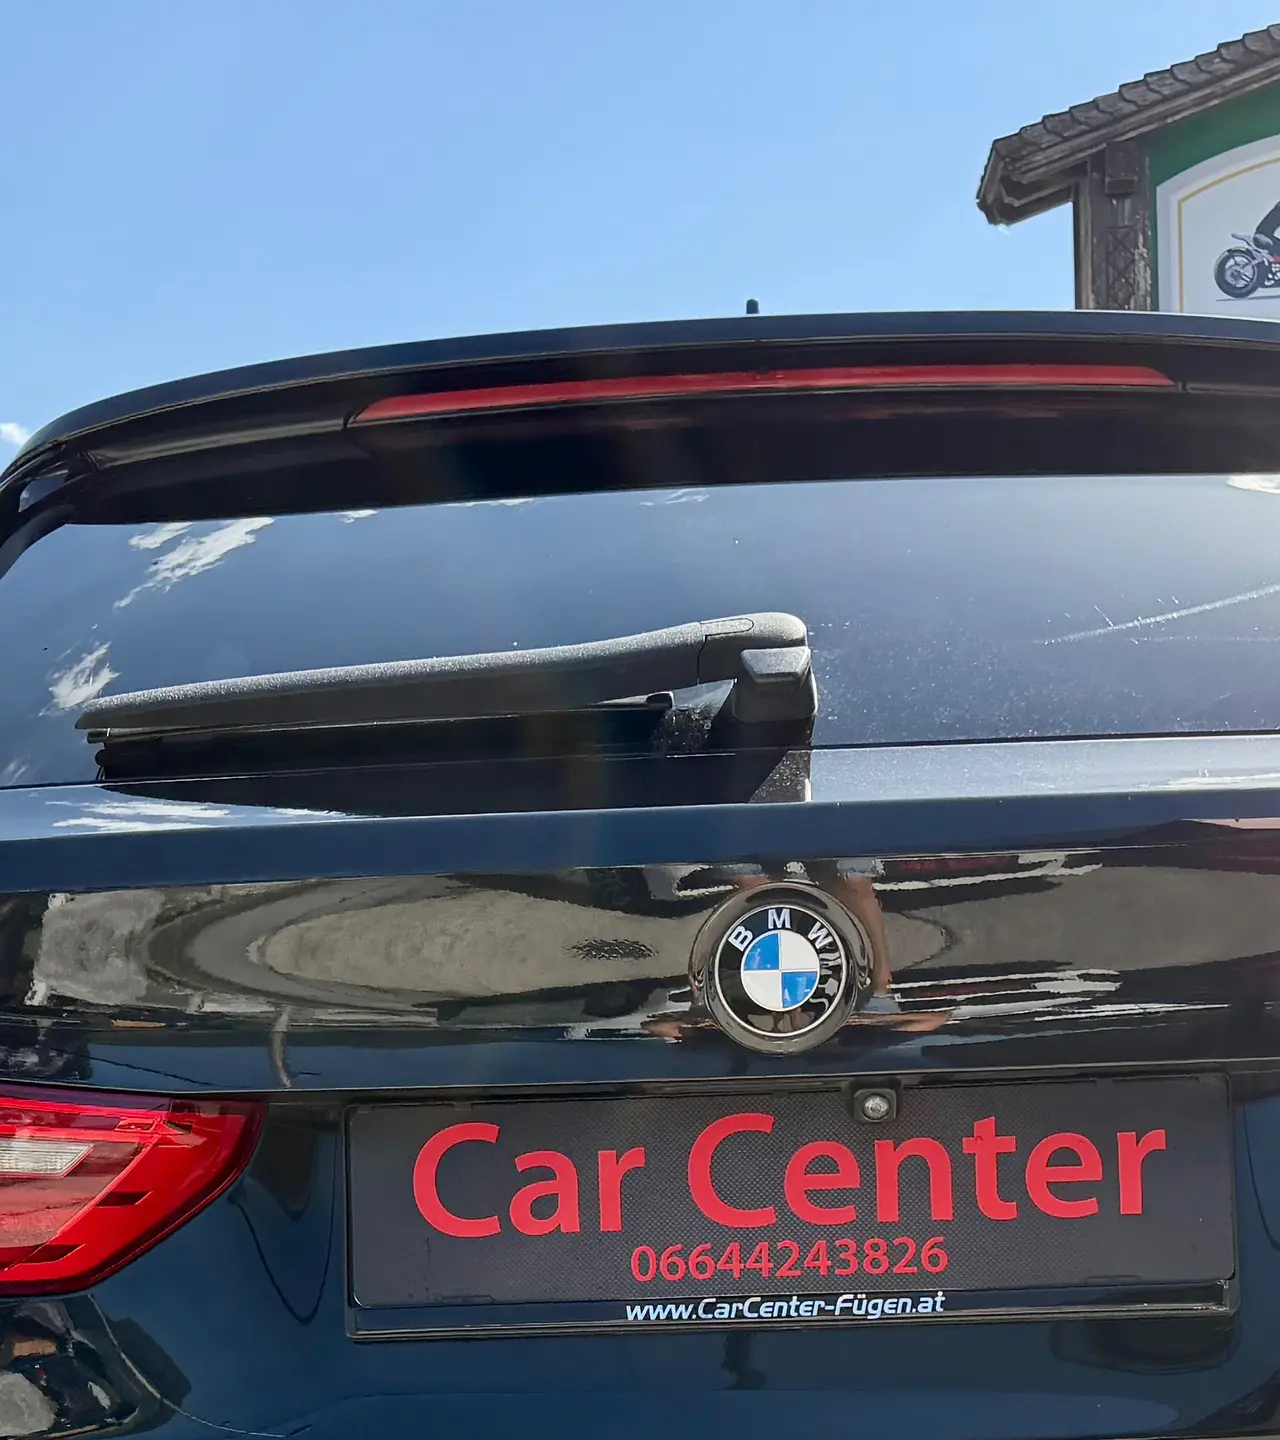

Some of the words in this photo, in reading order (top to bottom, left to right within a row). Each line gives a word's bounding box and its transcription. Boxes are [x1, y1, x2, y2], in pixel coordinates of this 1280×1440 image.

[728, 908, 835, 952] BMW
[412, 1121, 647, 1240] Car
[687, 1112, 1168, 1230] Center
[630, 1236, 950, 1283] 06644243826
[625, 1290, 947, 1322] www.CarCenter-Fügen.at
